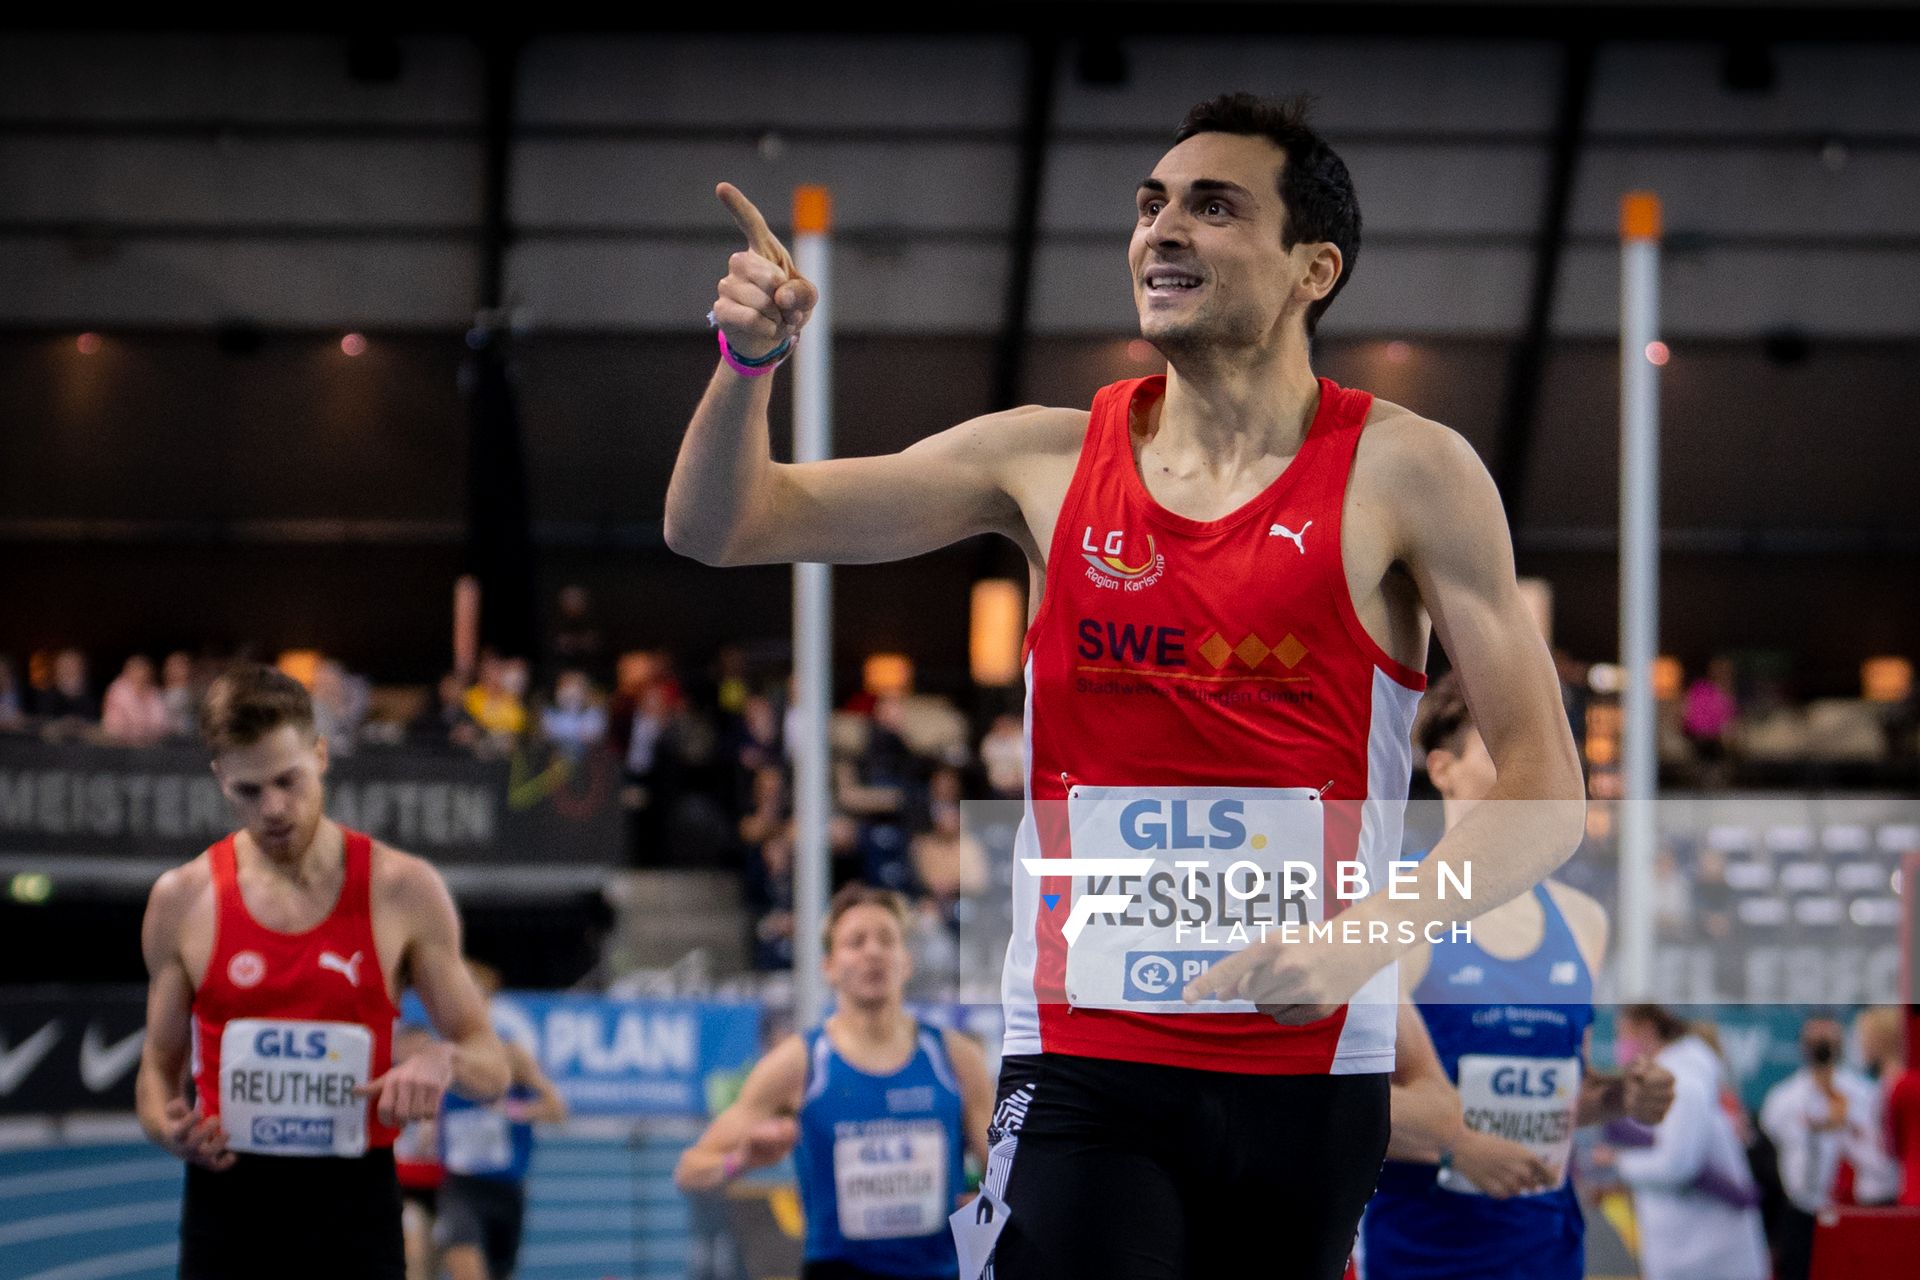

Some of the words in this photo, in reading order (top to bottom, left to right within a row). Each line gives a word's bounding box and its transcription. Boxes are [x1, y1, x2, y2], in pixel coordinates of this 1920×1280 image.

[1084, 566, 1119, 590] Region
[1124, 554, 1165, 592] Karlsruhe
[1077, 618, 1186, 668] SWE
[1086, 871, 1309, 928] KESSLER
[545, 1009, 697, 1074] PLAN
[230, 1069, 357, 1107] REUTHER
